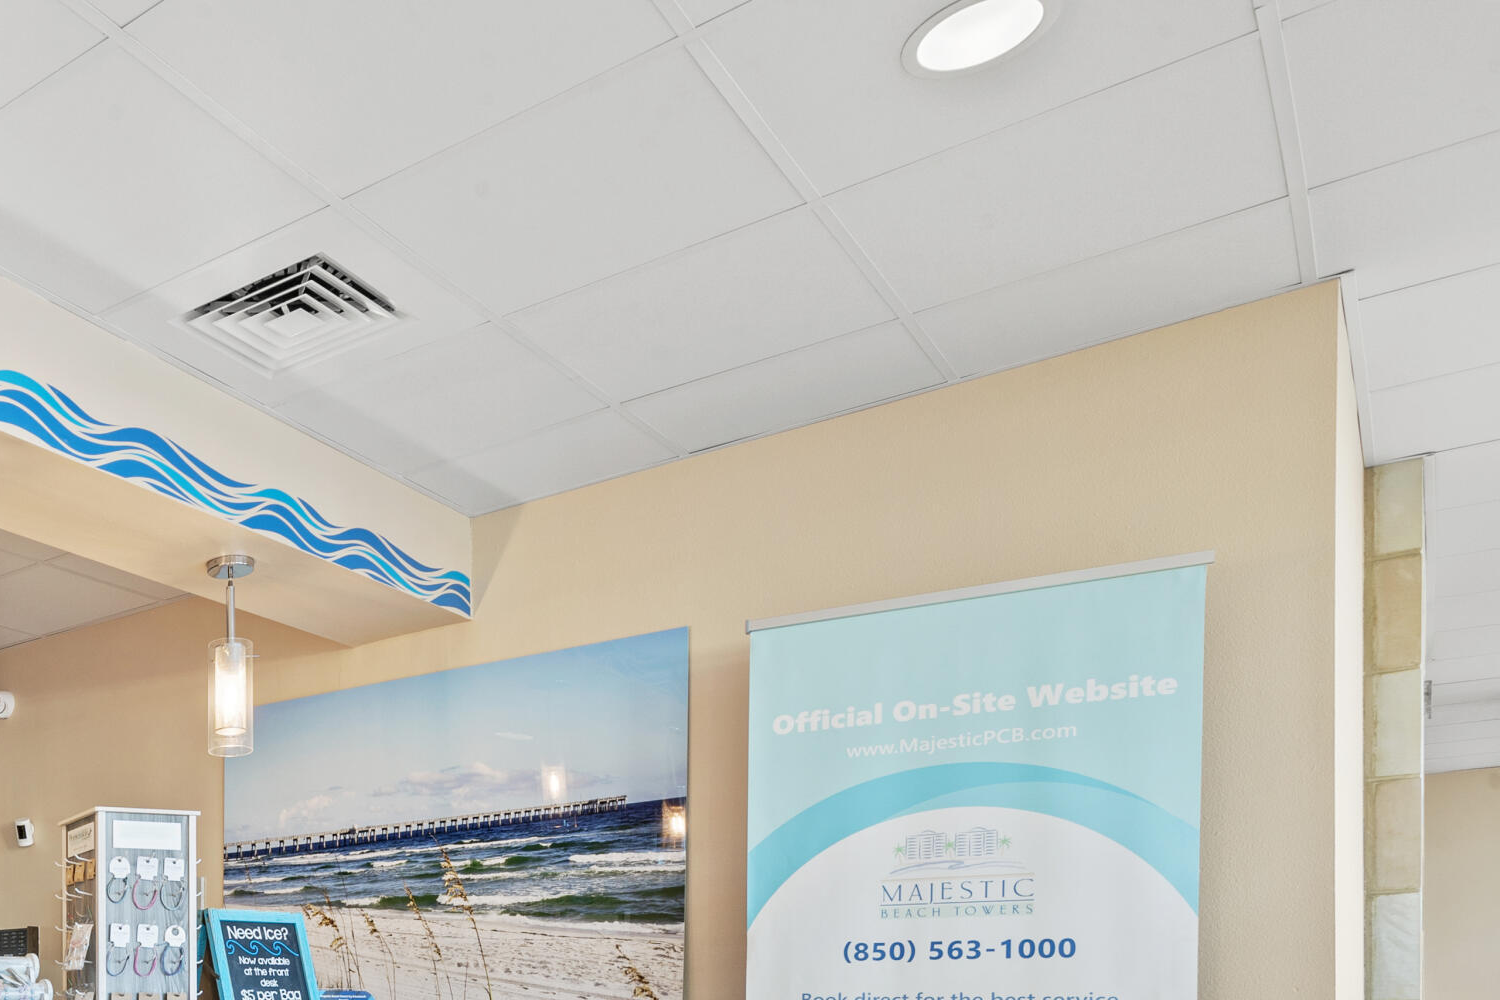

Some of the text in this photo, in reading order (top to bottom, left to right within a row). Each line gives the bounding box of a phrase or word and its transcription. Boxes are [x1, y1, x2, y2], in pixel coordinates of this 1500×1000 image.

[773, 675, 1178, 735] Official On-Site Website
[846, 723, 1077, 758] www.MajesticPCB.com
[881, 878, 1036, 904] MAJESTIC
[881, 903, 1035, 919] BEACH TOWERS
[227, 926, 288, 940] Need Ice?
[843, 938, 1077, 965] (850) 563-1000
[239, 956, 290, 966] Now available
[244, 967, 289, 977] at the front
[260, 978, 278, 987] desk
